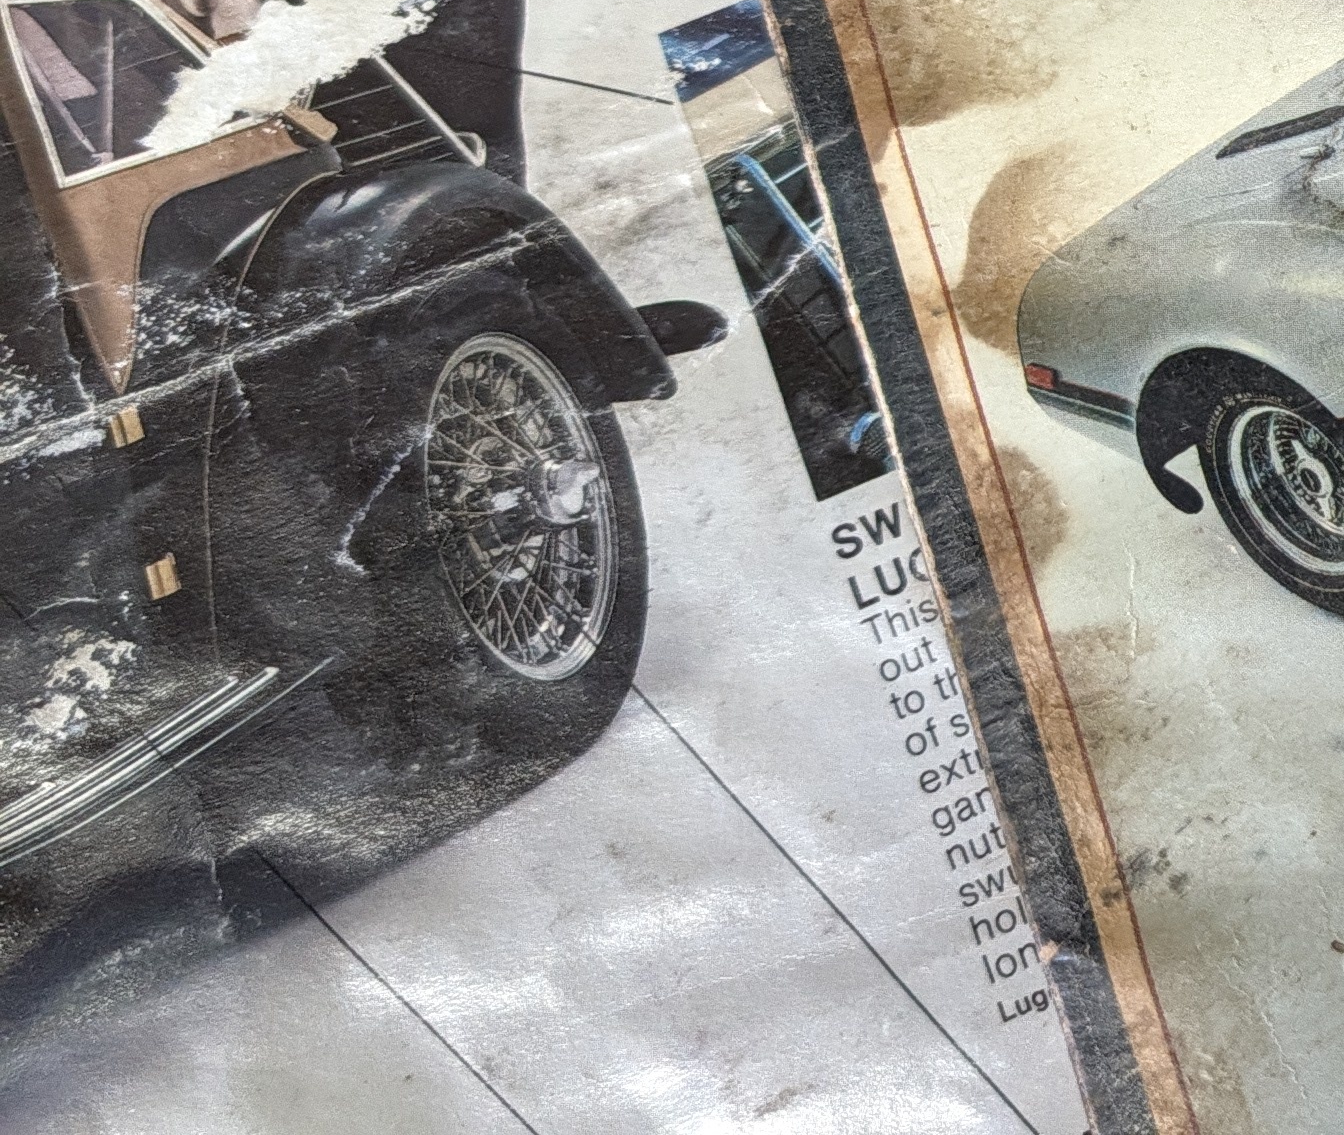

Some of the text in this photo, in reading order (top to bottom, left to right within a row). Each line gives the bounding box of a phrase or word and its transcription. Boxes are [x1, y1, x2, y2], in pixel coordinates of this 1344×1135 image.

[831, 501, 902, 559] SW
[860, 599, 940, 645] This
[880, 636, 938, 682] out
[890, 690, 925, 720] to
[905, 716, 940, 756] of
[946, 822, 1007, 870] nut
[969, 895, 1028, 946] hol
[982, 942, 1040, 984] lon
[997, 988, 1050, 1023] Lug
